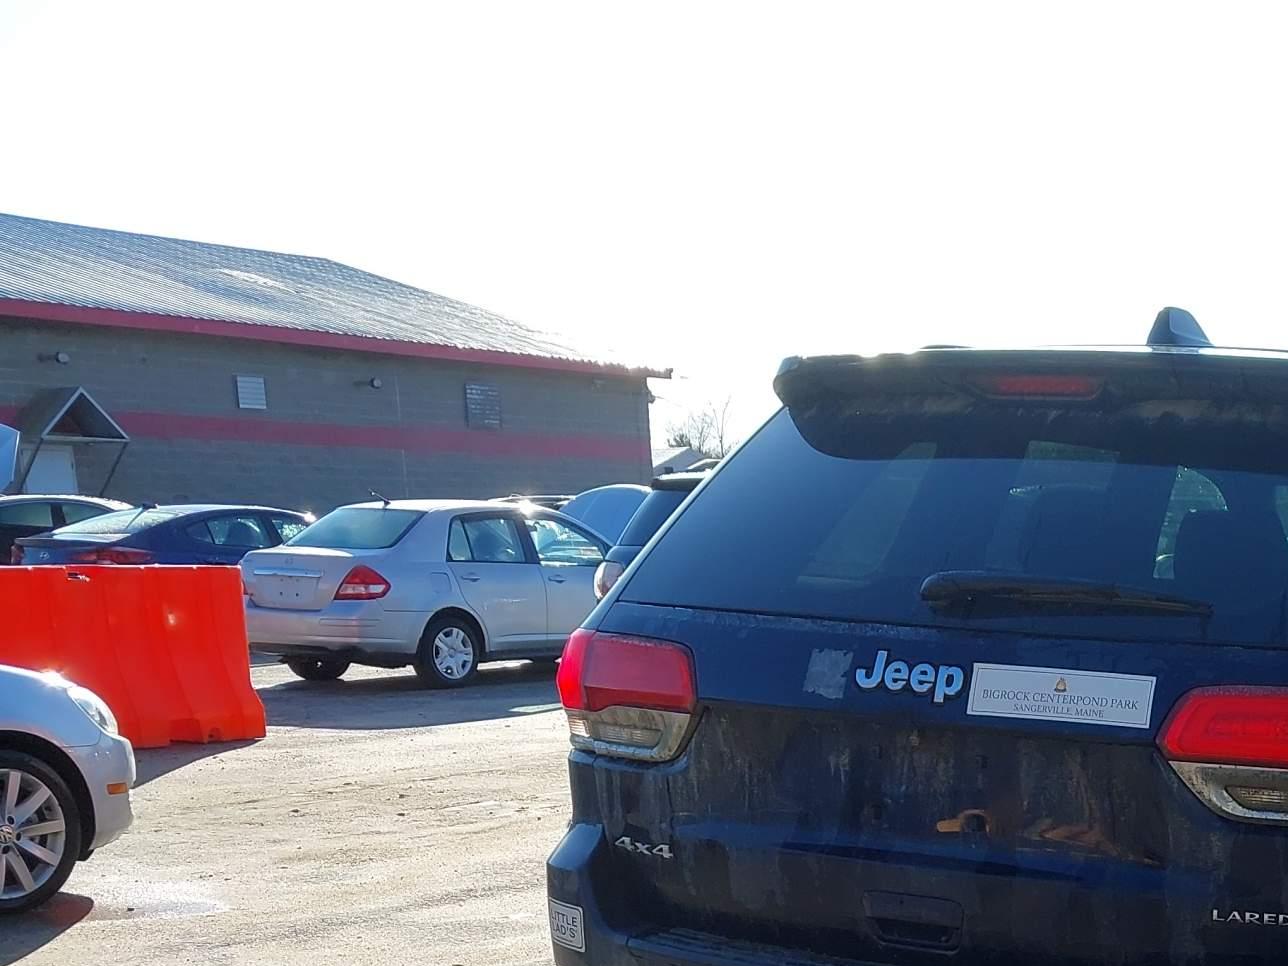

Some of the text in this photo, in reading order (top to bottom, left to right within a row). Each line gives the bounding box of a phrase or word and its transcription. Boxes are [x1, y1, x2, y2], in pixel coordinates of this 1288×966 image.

[855, 650, 964, 703] Jeep
[982, 689, 1139, 710] BIGROCK CENTERPOND PARK
[1074, 708, 1104, 718] MAINE
[615, 836, 674, 859] 4x4
